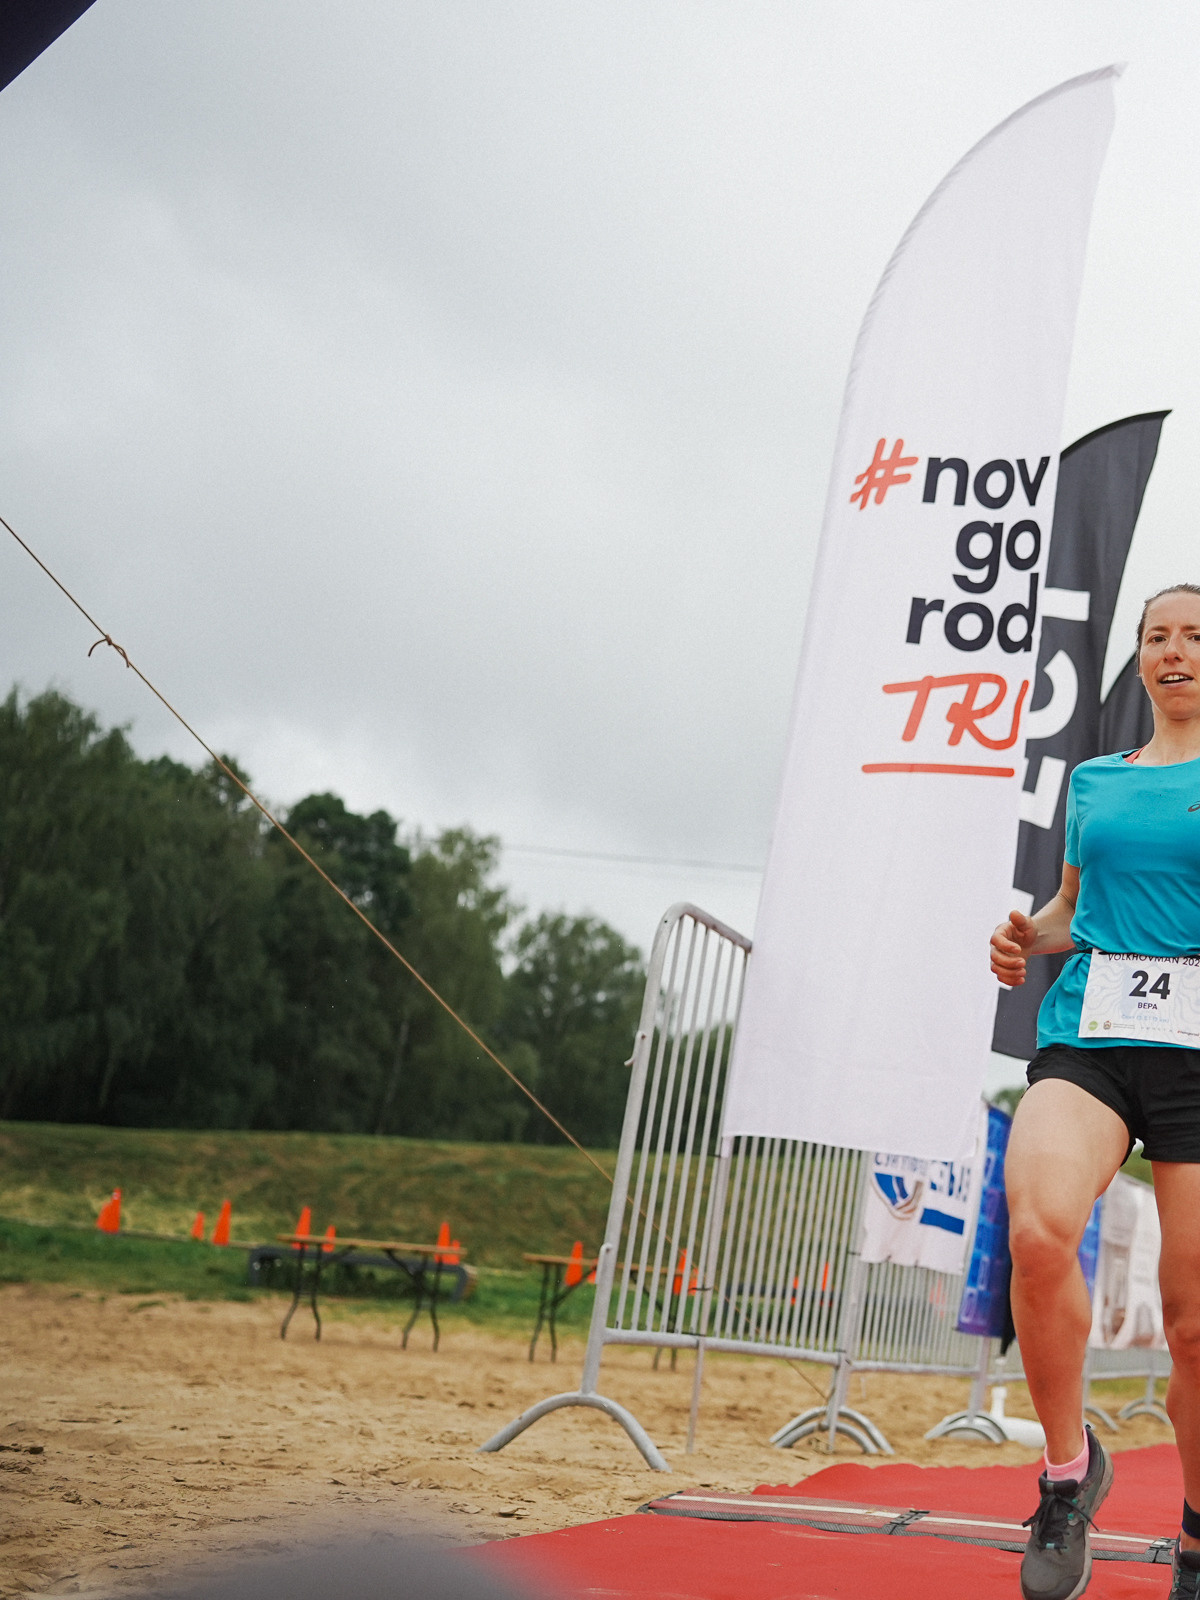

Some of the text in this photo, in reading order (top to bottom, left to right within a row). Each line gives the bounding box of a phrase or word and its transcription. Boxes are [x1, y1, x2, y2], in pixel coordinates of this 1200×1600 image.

[952, 519, 1041, 594] go
[905, 572, 1039, 653] rod
[882, 672, 1029, 750] TRI
[1107, 953, 1179, 965] VOLKHOVMAN
[1129, 970, 1171, 1000] 24
[1137, 1002, 1158, 1010] ВЕРА
